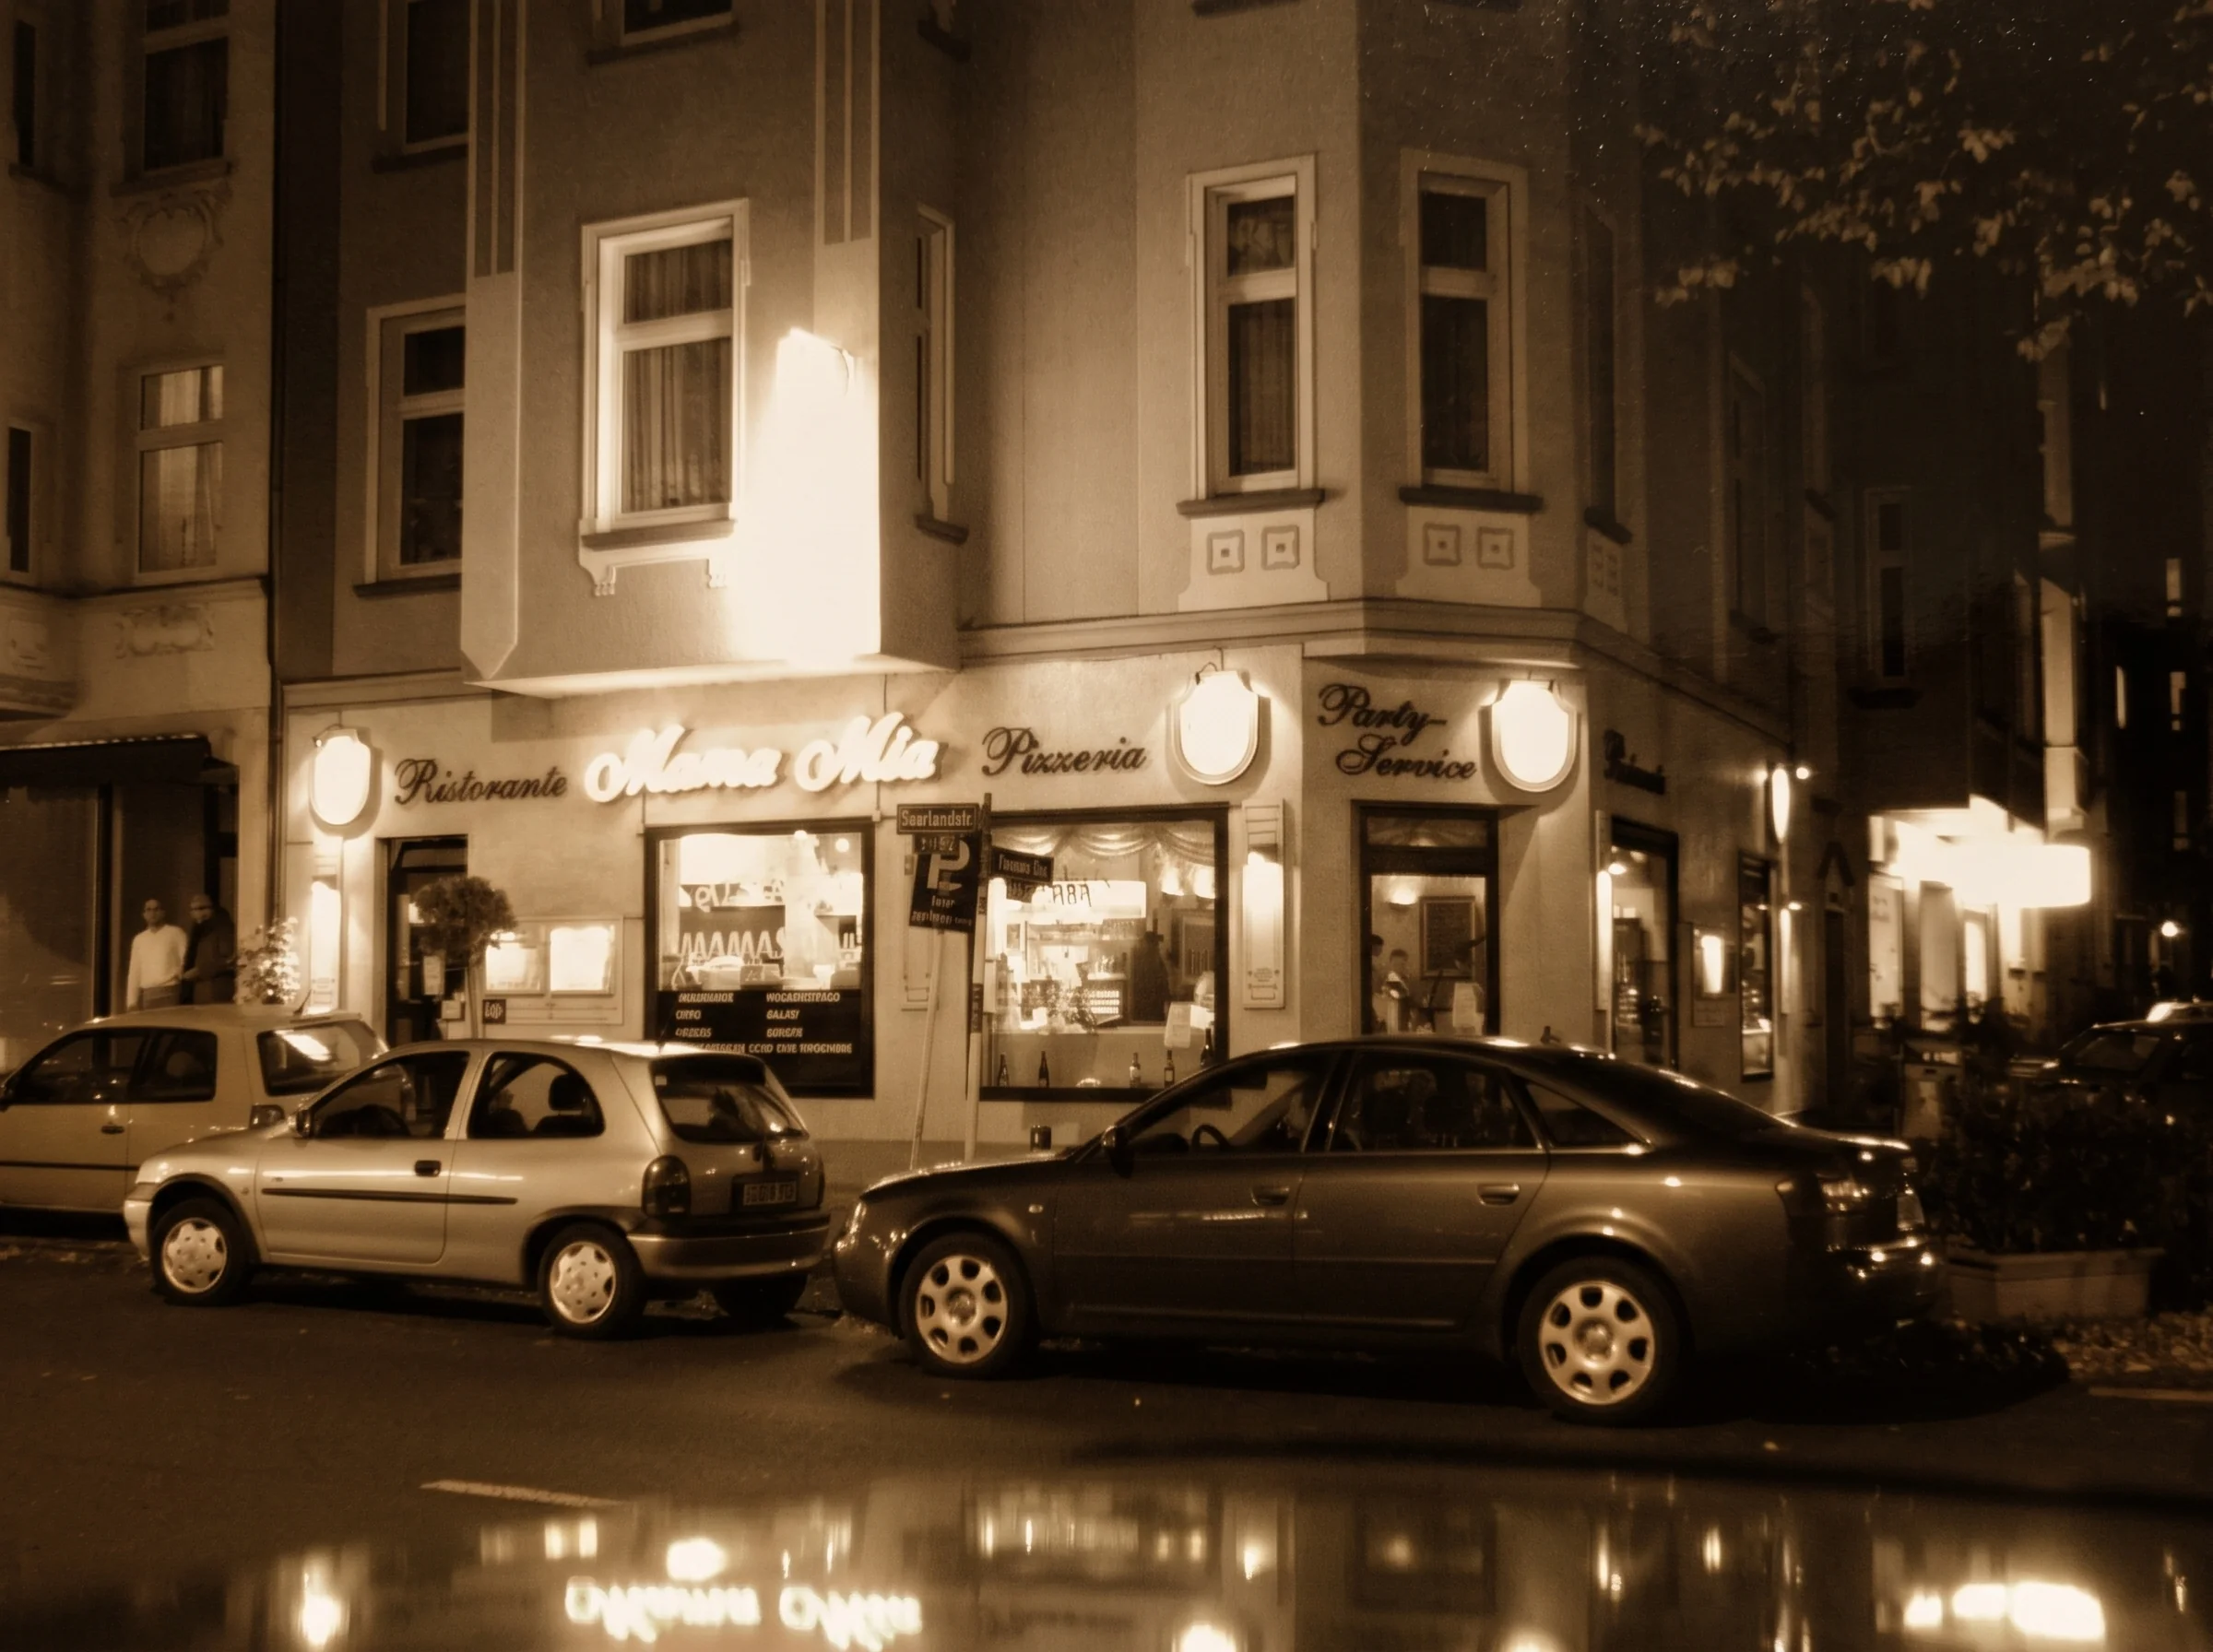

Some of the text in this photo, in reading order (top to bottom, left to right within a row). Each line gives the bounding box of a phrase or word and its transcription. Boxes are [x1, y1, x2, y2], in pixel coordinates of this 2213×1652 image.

[1318, 683, 1448, 746] Party-
[394, 712, 1147, 805] Ristorante Mama Mia Pizzeria
[1335, 734, 1477, 779] Service
